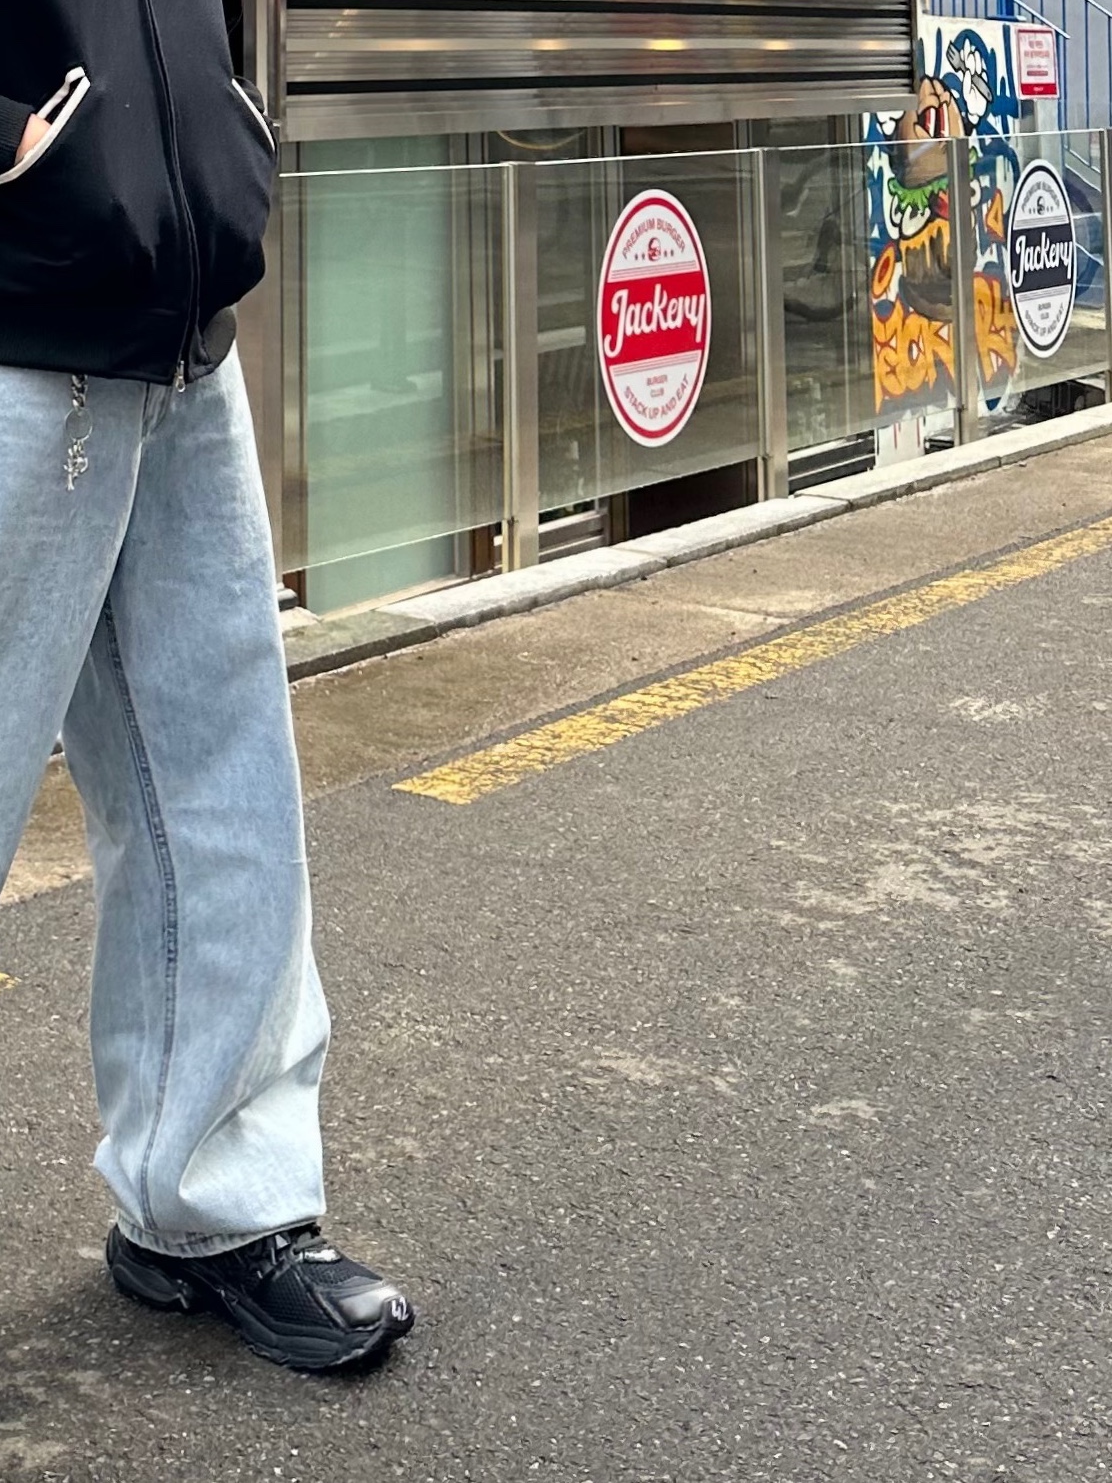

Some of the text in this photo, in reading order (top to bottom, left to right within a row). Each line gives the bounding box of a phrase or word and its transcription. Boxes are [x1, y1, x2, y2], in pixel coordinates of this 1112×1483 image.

[622, 217, 686, 260] PREMIUM BURGER
[1012, 231, 1073, 288] Jackery
[603, 283, 706, 358] Jackery
[624, 373, 689, 420] STACK UP AND EAT
